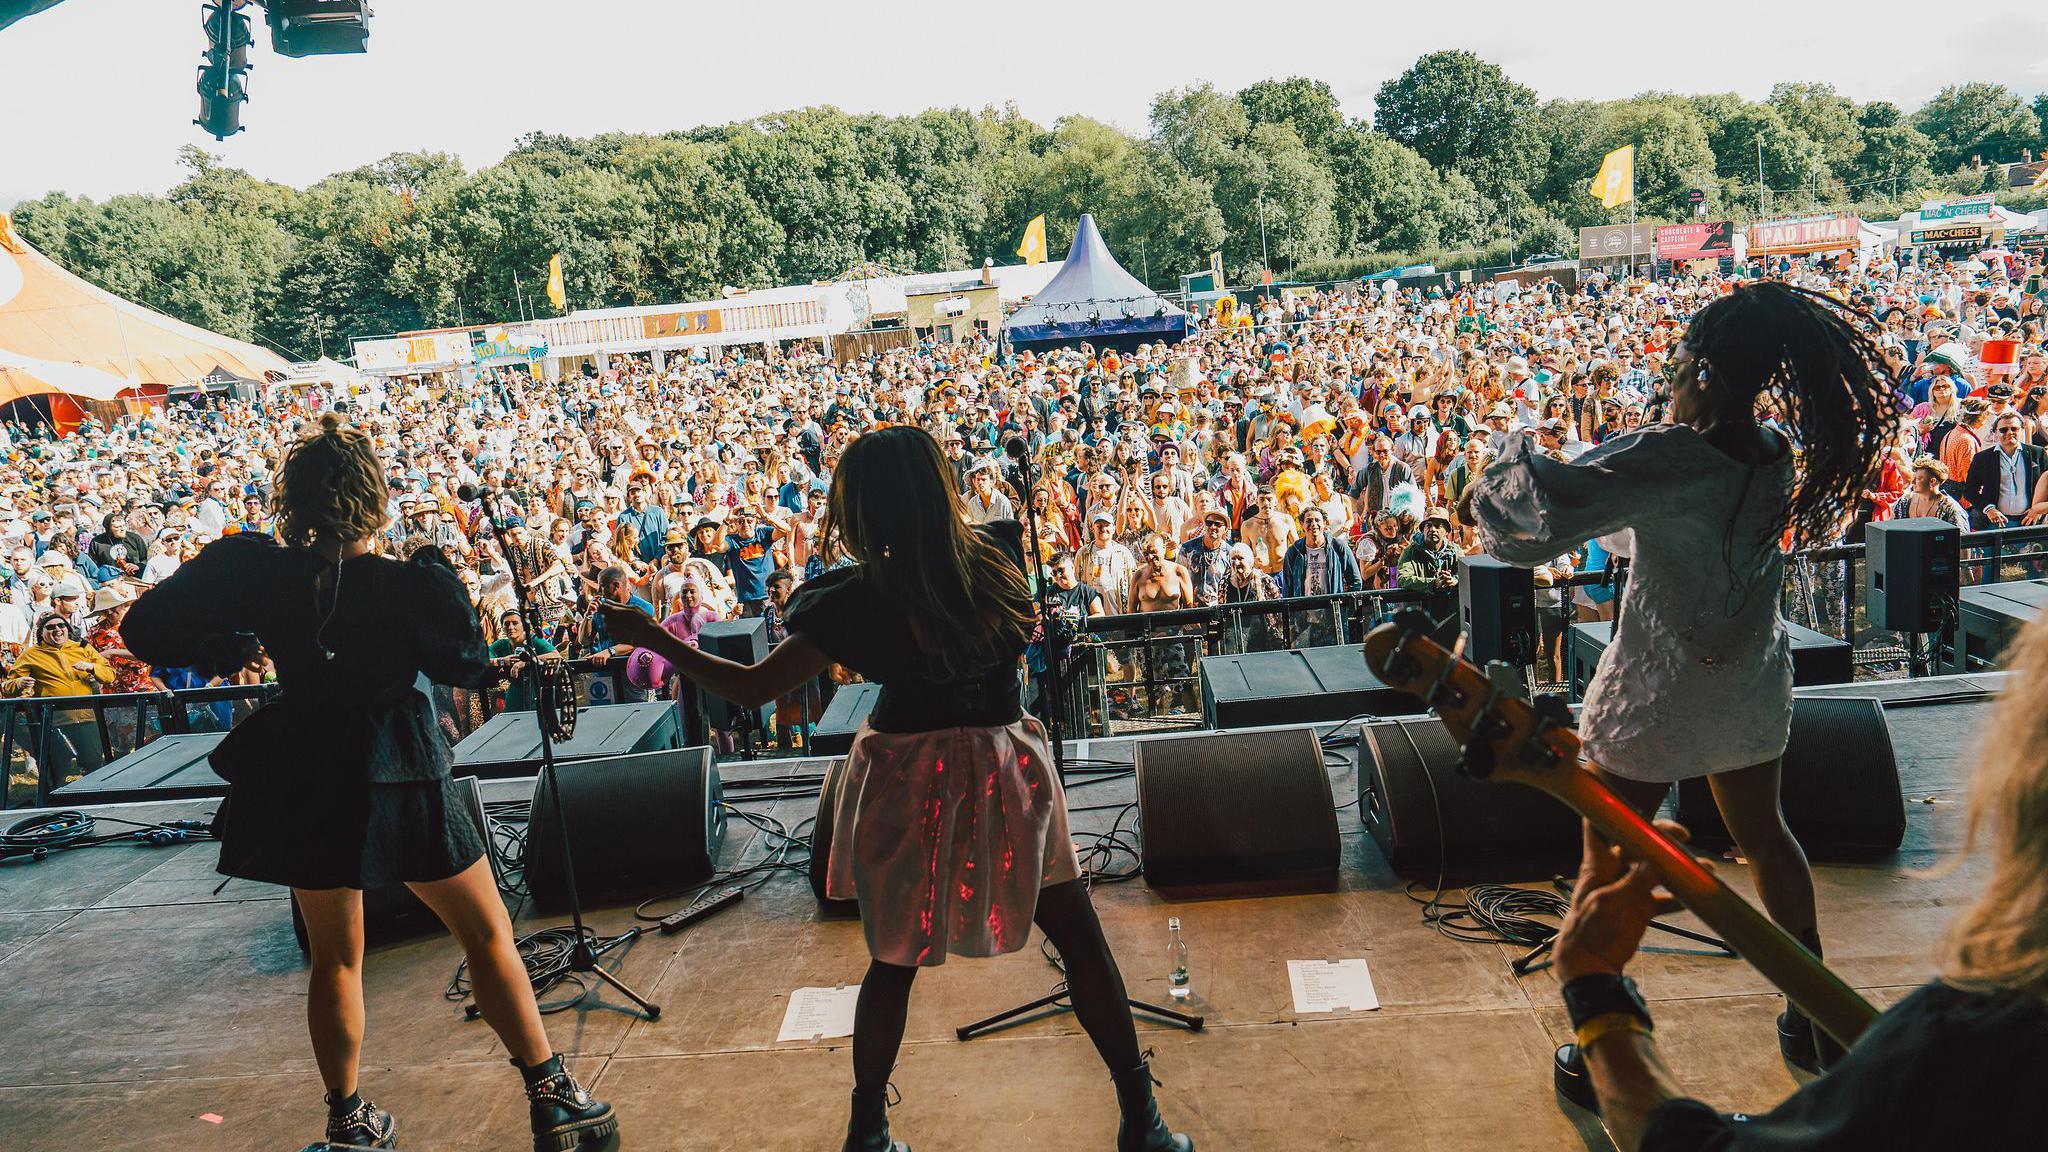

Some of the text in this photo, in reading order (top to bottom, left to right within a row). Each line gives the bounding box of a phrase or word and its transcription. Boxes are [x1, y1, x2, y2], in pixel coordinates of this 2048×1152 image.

[1924, 208, 1942, 219] MAC
[1955, 204, 1989, 216] CHEESE
[1661, 227, 1693, 236] CHOCOLATE
[1763, 218, 1846, 246] PAD THAI
[1924, 229, 1945, 239] MAC
[1949, 227, 1979, 238] CHEESE
